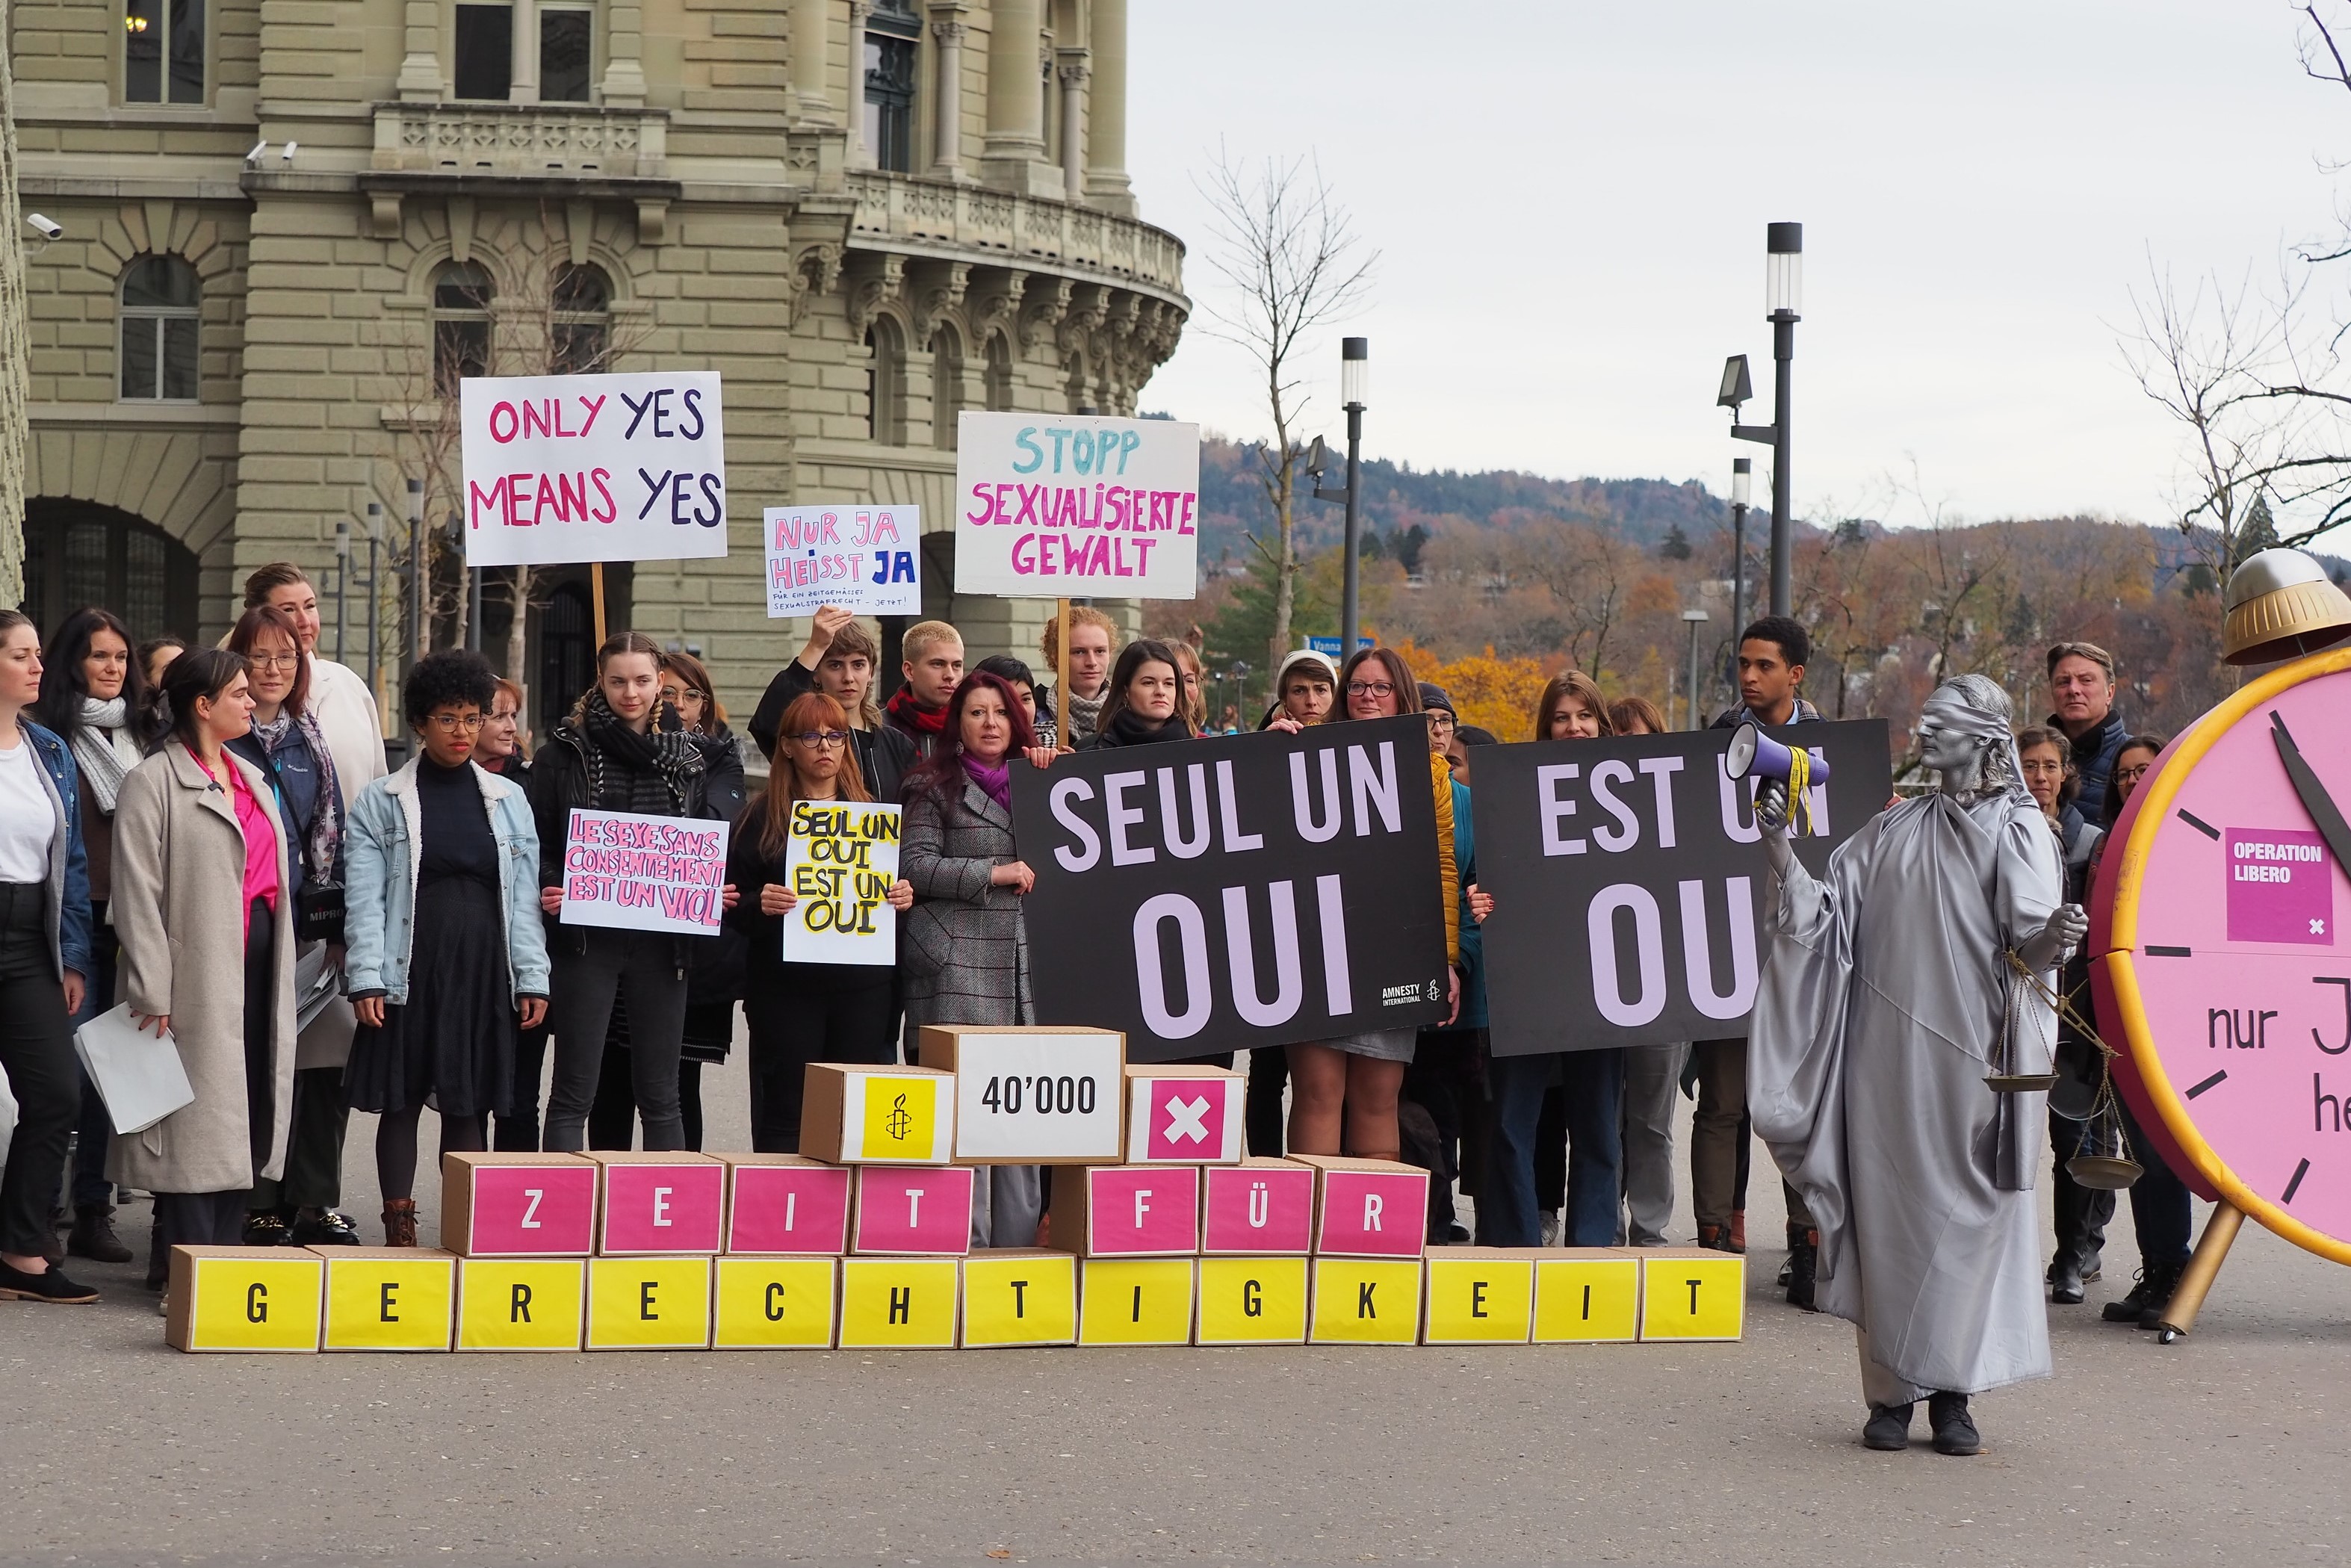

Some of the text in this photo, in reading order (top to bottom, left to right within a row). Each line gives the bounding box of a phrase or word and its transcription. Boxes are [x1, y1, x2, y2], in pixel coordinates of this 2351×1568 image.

[489, 388, 704, 444] ONLY YES
[1012, 427, 1141, 476] STOPP
[470, 468, 722, 529] MEANS YES
[851, 512, 900, 547] JA
[872, 551, 916, 585] JA
[1011, 533, 1157, 577] GEWALT
[773, 591, 788, 600] FÜR
[876, 596, 908, 607] JETZT!
[793, 802, 899, 840] SEUL UN
[1049, 741, 1402, 873] SEUL UN
[1537, 756, 1684, 857] EST
[570, 814, 720, 861] LE SEXE SANS
[811, 838, 871, 869] OUI
[2234, 842, 2322, 862] OPERATION
[565, 846, 726, 887] CONSENTEMENT
[796, 867, 891, 899] EST UN
[2234, 864, 2290, 883] LIBERO
[569, 875, 721, 927] EST UN VIOL
[805, 899, 879, 934] OUI
[1133, 874, 1352, 1039] OUI
[1588, 876, 1759, 1027] OU
[1382, 984, 1420, 999] AMNESTY
[1383, 995, 1421, 1007] INTERNATIONAL
[2208, 976, 2351, 1055] nur J
